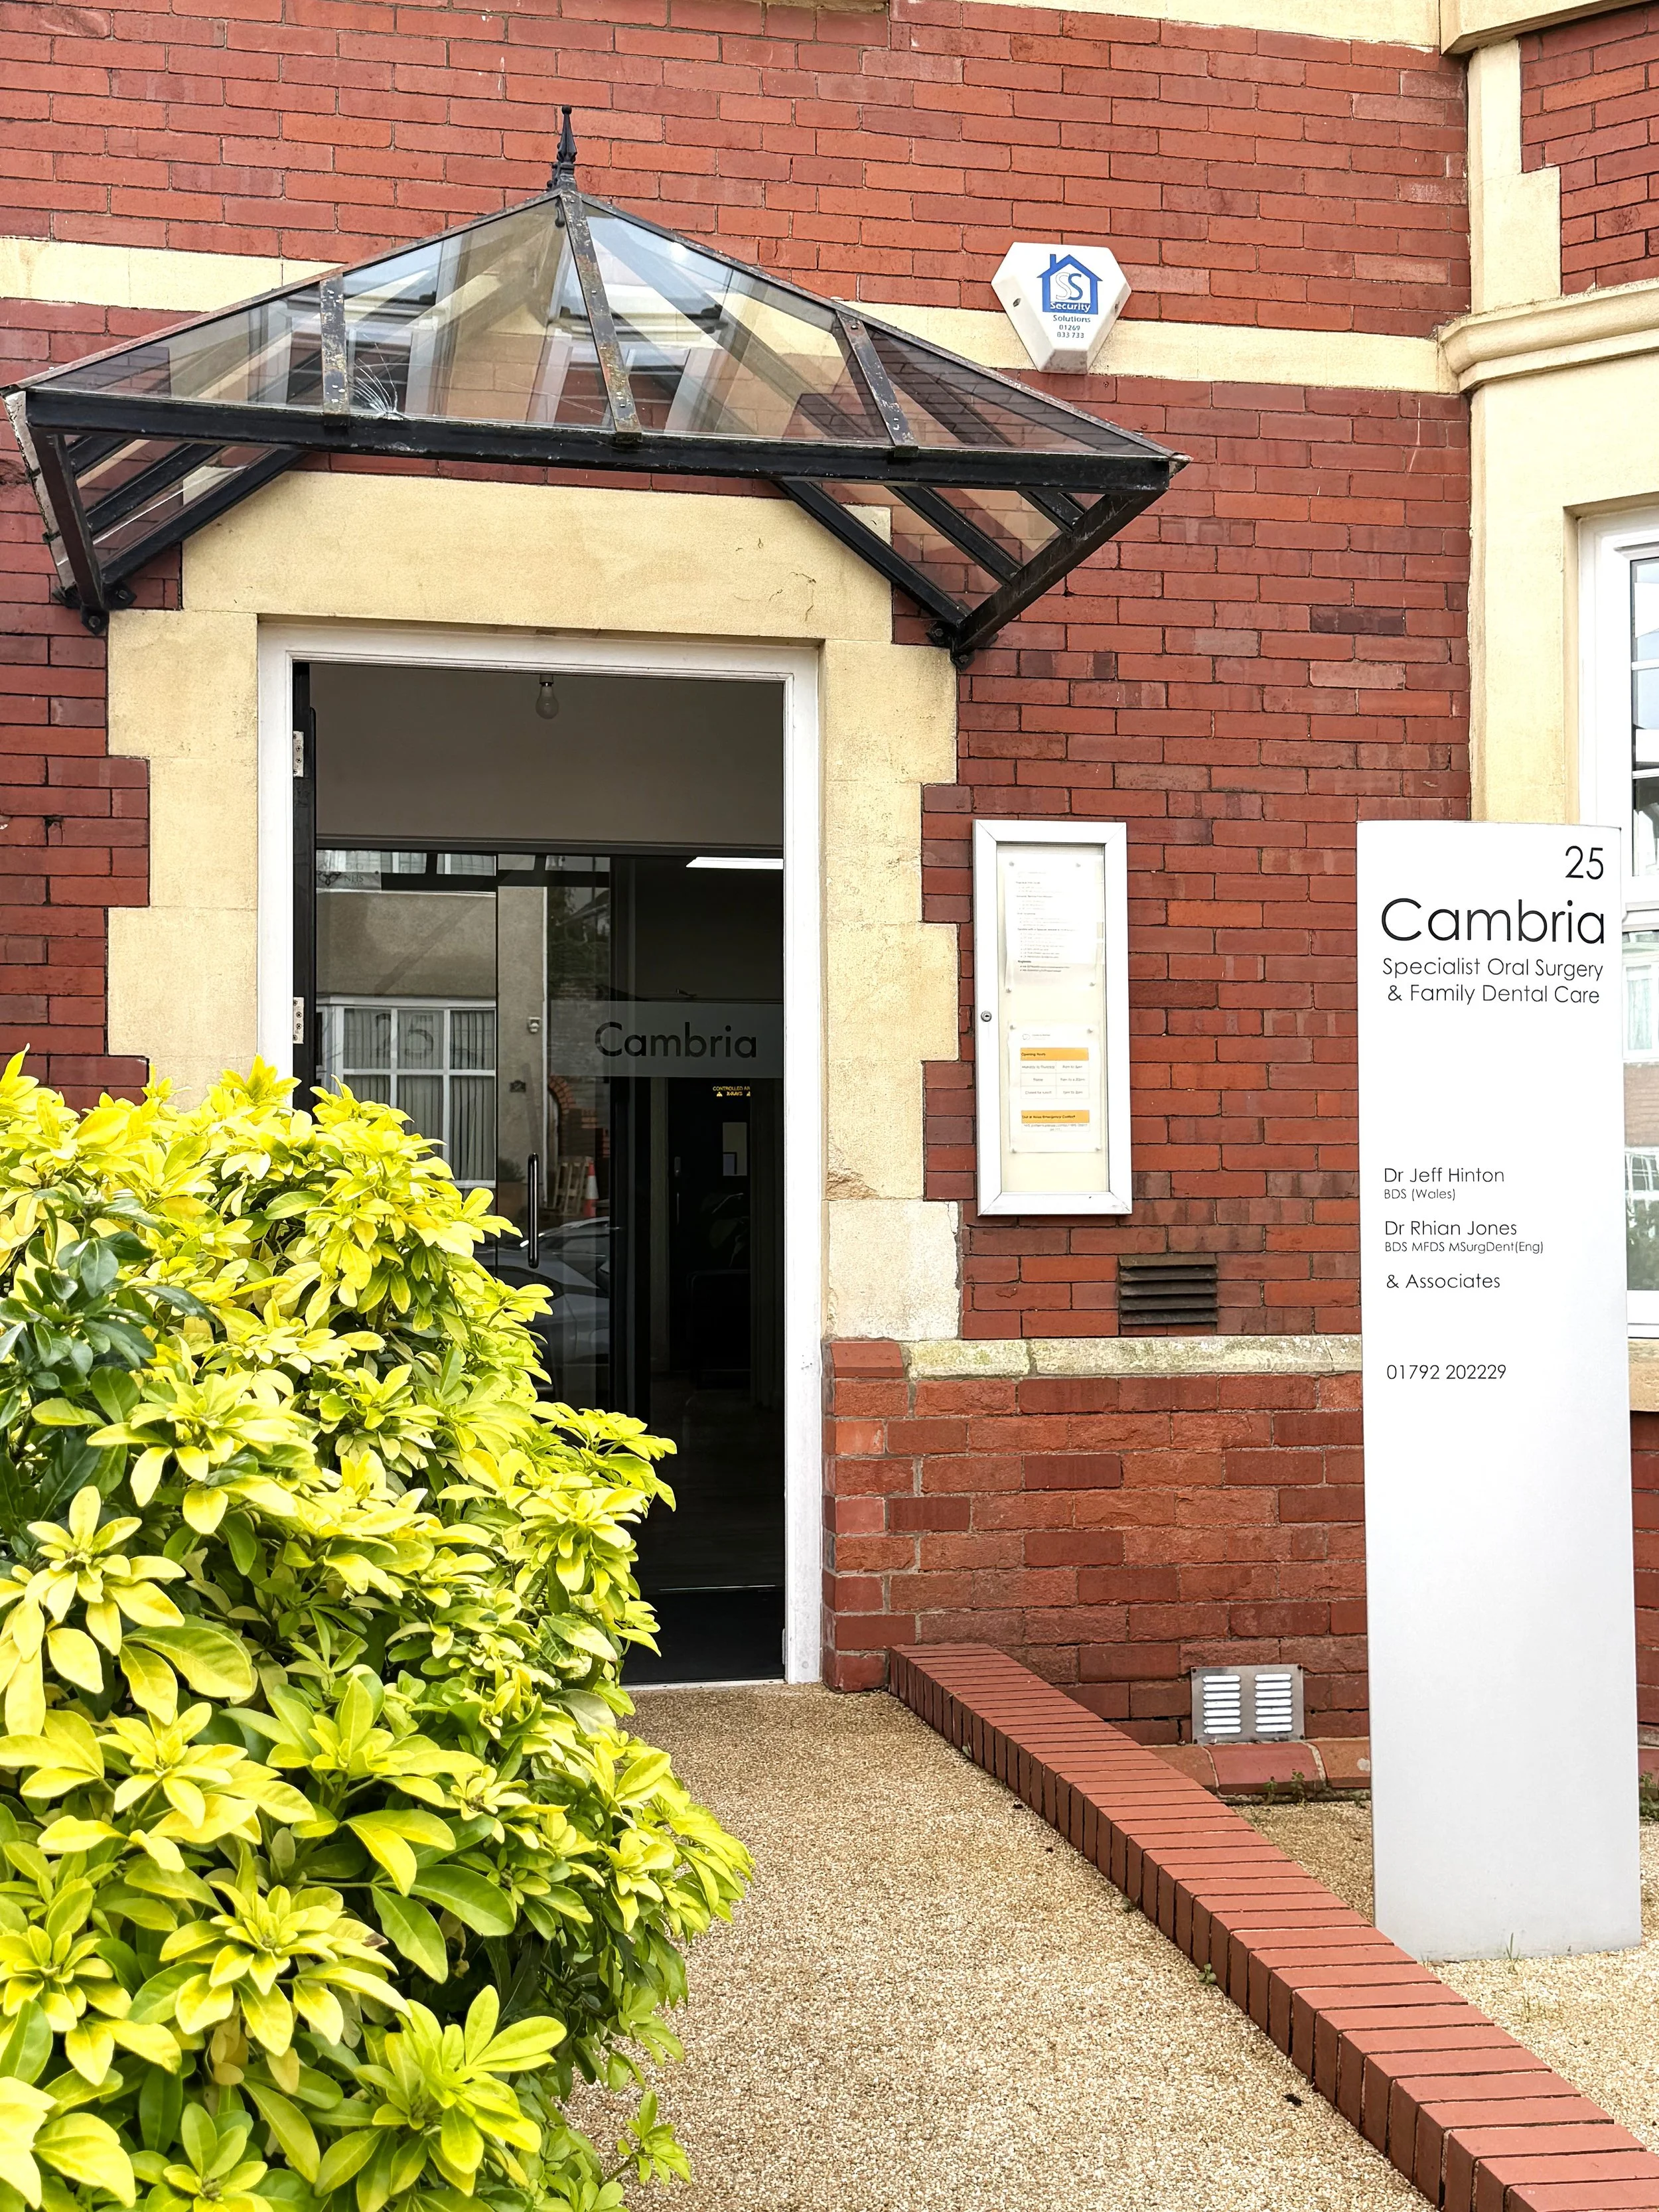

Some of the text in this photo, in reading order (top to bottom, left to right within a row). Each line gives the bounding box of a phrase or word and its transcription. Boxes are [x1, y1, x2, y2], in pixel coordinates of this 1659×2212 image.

[1050, 302, 1090, 313] Security
[1565, 846, 1603, 879] 25
[1382, 898, 1604, 944] Cambria
[1383, 957, 1603, 981] Specialist Oral Surgery
[1388, 984, 1599, 1005] & Family Dental Care
[595, 1021, 757, 1058] Cambria
[1385, 1167, 1504, 1183] Dr Jeff Hinton
[1384, 1188, 1455, 1201] BDS (Wales)
[1385, 1220, 1517, 1236] Dr Rhian Jones
[1385, 1241, 1544, 1254] BDS MFDS MSurgDent(Eng)
[1386, 1274, 1500, 1288] & Associates
[1386, 1364, 1506, 1379] 01792 202229
